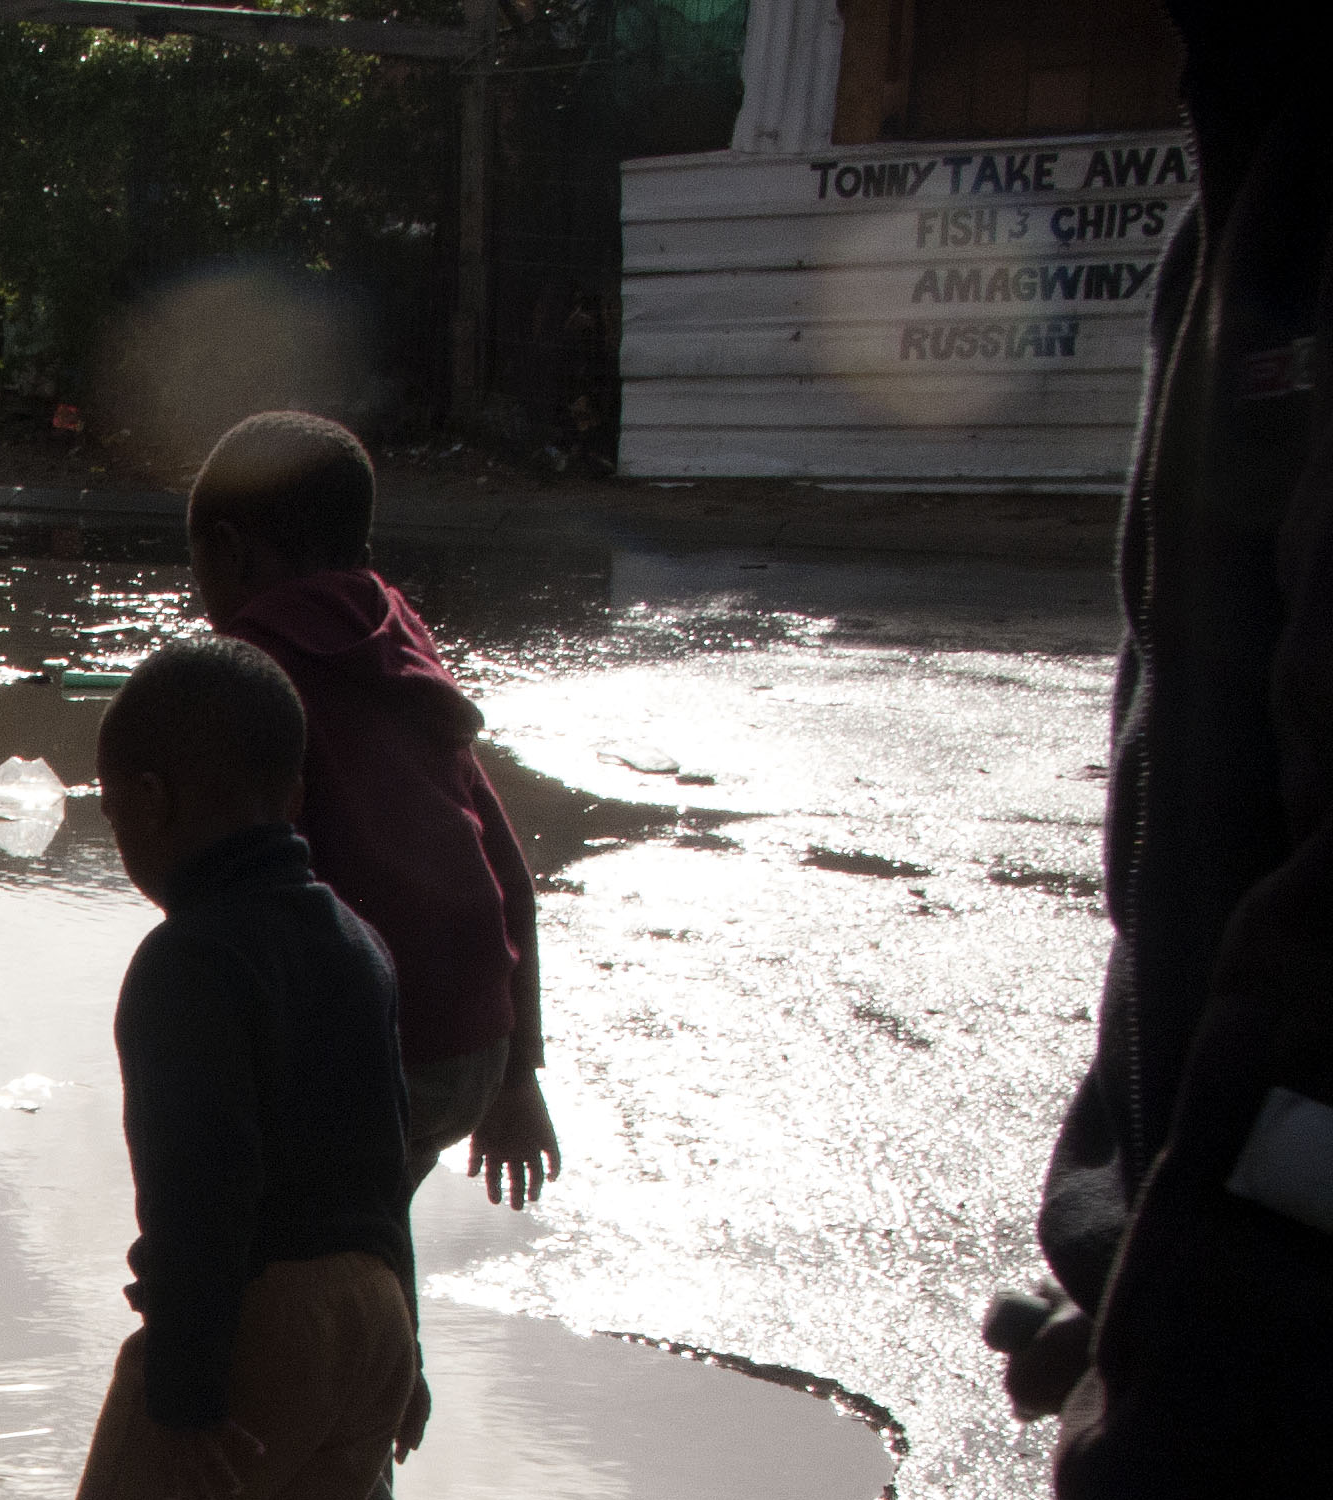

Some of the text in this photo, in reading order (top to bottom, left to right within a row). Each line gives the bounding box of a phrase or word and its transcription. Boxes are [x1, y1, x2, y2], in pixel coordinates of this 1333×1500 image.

[811, 147, 1191, 199] TONNY TAKE AWA
[918, 207, 996, 247] FISH
[1051, 202, 1167, 243] CHIPS
[913, 263, 1156, 302] AMAGWINY
[900, 319, 1080, 360] RUSSIAN
